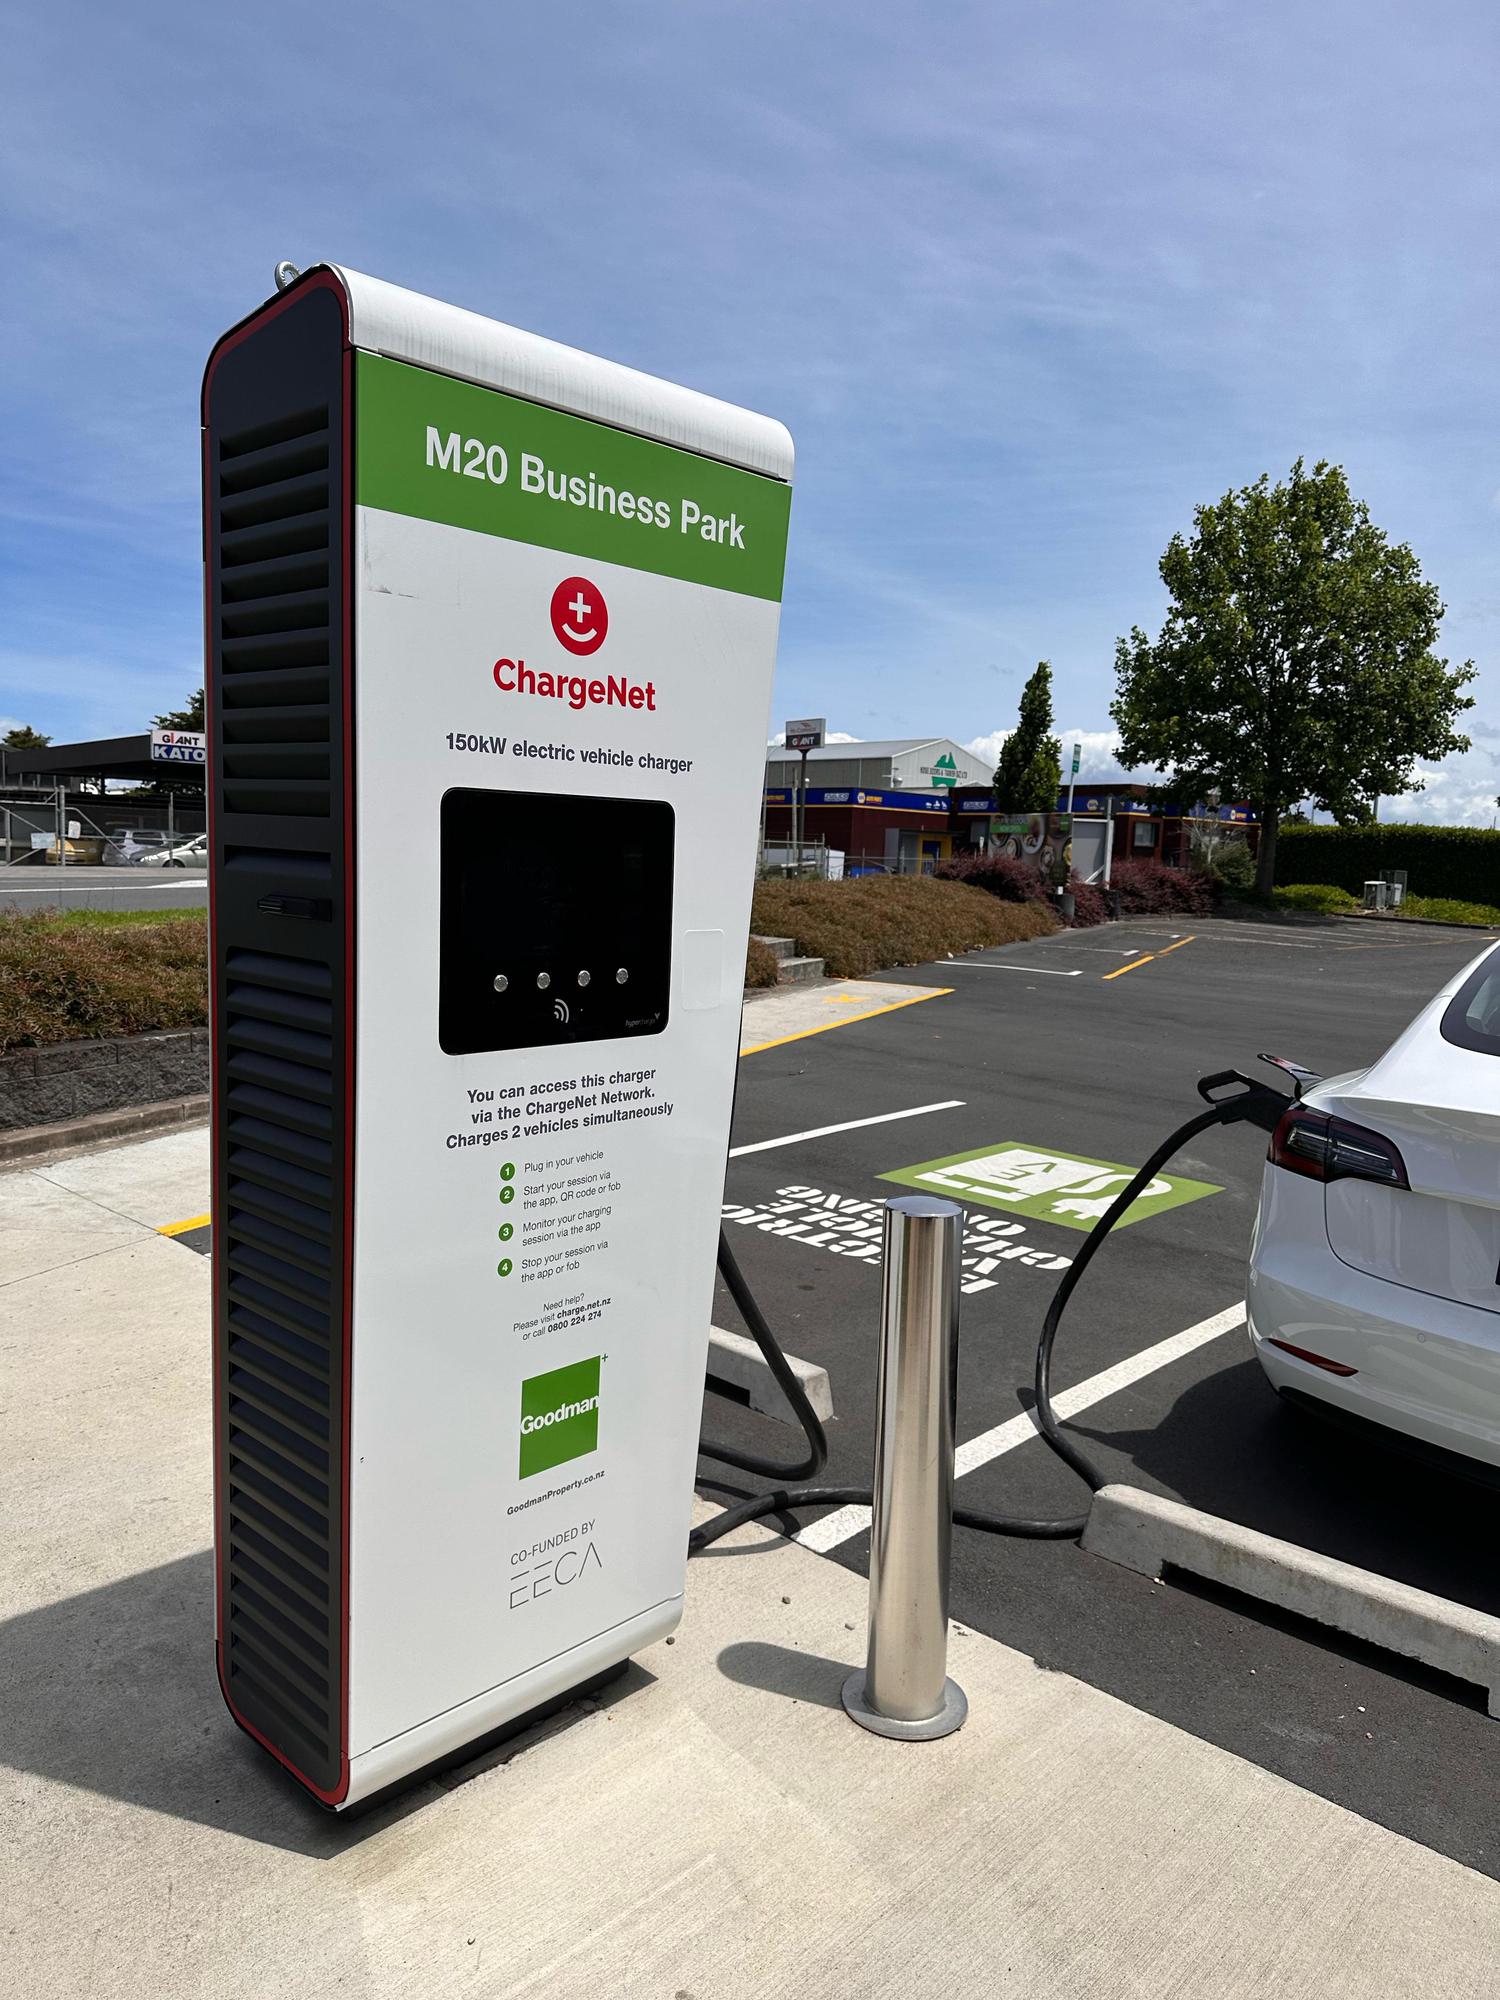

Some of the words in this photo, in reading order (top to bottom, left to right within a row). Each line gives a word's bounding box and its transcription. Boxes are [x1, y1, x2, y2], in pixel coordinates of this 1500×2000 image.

[425, 425, 508, 485] M20
[520, 452, 671, 529] Business
[680, 499, 746, 550] Park
[492, 658, 657, 711] ChargeNet
[154, 745, 206, 762] KATO
[445, 732, 507, 756] 150kW
[512, 740, 576, 762] electric
[579, 747, 634, 768] vehicle
[638, 752, 694, 775] charger
[467, 1089, 495, 1104] You
[499, 1085, 525, 1100] can
[529, 1078, 577, 1096] access
[581, 1073, 605, 1089] this
[608, 1068, 657, 1085] charger
[471, 1110, 493, 1124] via
[497, 1105, 521, 1120] the
[525, 1094, 597, 1116] ChargeNet
[601, 1086, 655, 1105] Network.
[446, 1129, 509, 1149] Charges
[512, 1125, 521, 1139] 2
[523, 1116, 579, 1136] vehicles
[582, 1102, 674, 1127] simultaneously
[524, 1162, 544, 1173] Plug
[546, 1160, 554, 1169] in
[555, 1155, 575, 1169] your
[576, 1150, 604, 1164] vehicle
[523, 1184, 545, 1196] Start
[546, 1180, 565, 1193] your
[567, 1174, 598, 1187] session
[599, 1171, 611, 1180] via
[523, 1199, 537, 1210] the
[539, 1195, 558, 1208] app,
[560, 1191, 574, 1202] QR
[575, 1187, 597, 1198] code
[598, 1185, 607, 1194] or
[608, 1182, 621, 1192] fob
[522, 1220, 555, 1233] Monitor
[557, 1213, 576, 1227] your
[577, 1205, 612, 1220] charging
[522, 1232, 554, 1247] session
[556, 1229, 569, 1239] via
[570, 1224, 583, 1235] the
[585, 1221, 601, 1232] app
[521, 1258, 542, 1270] Stop
[544, 1252, 563, 1265] your
[564, 1245, 595, 1258] session
[597, 1240, 609, 1250] via
[521, 1273, 535, 1283] the
[537, 1268, 554, 1280] app
[555, 1265, 565, 1274] or
[566, 1260, 580, 1271] fob
[513, 1318, 539, 1332] Please
[540, 1313, 555, 1323] visit
[556, 1297, 612, 1319] charge.net.nz
[543, 1299, 563, 1312] Need
[564, 1293, 585, 1306] help?
[522, 1332, 531, 1341] or
[532, 1327, 546, 1338] call
[547, 1319, 569, 1333] 0800
[570, 1315, 586, 1327] 224
[588, 1310, 602, 1322] 274
[520, 1394, 600, 1435] Goodman
[507, 1469, 605, 1516] GoodmanProperty.co.nz
[510, 1526, 579, 1566] CO-FUNDED
[581, 1519, 596, 1539] BY
[509, 1541, 602, 1610] EECA
